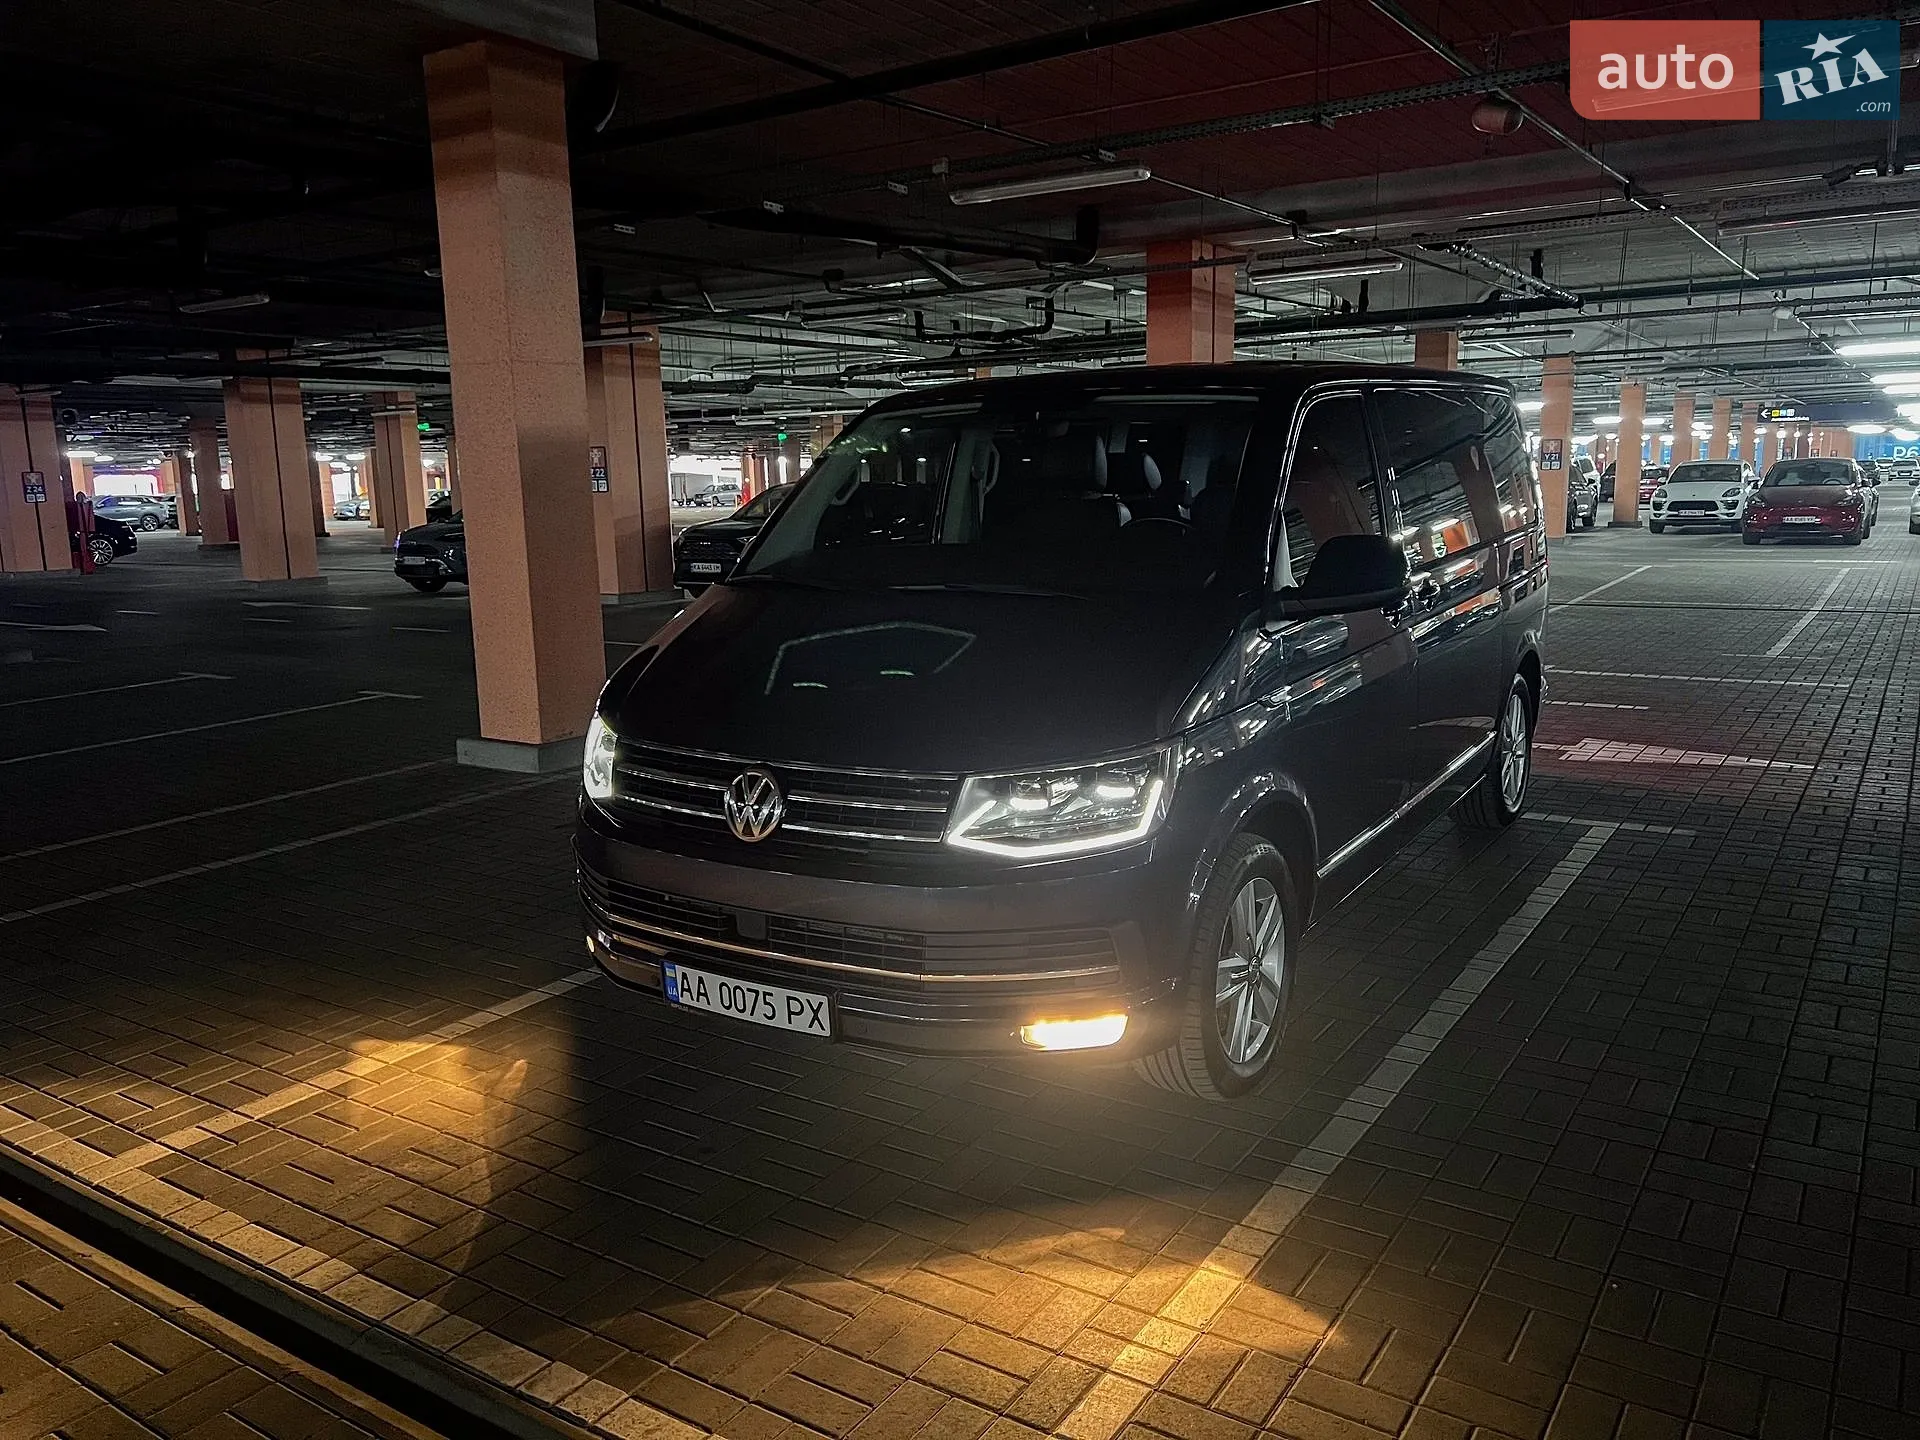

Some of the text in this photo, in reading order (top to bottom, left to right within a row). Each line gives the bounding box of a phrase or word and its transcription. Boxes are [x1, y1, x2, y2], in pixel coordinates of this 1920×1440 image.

[595, 468, 605, 477] 22
[667, 985, 678, 997] UA
[680, 971, 826, 1031] AA 0075 PX
